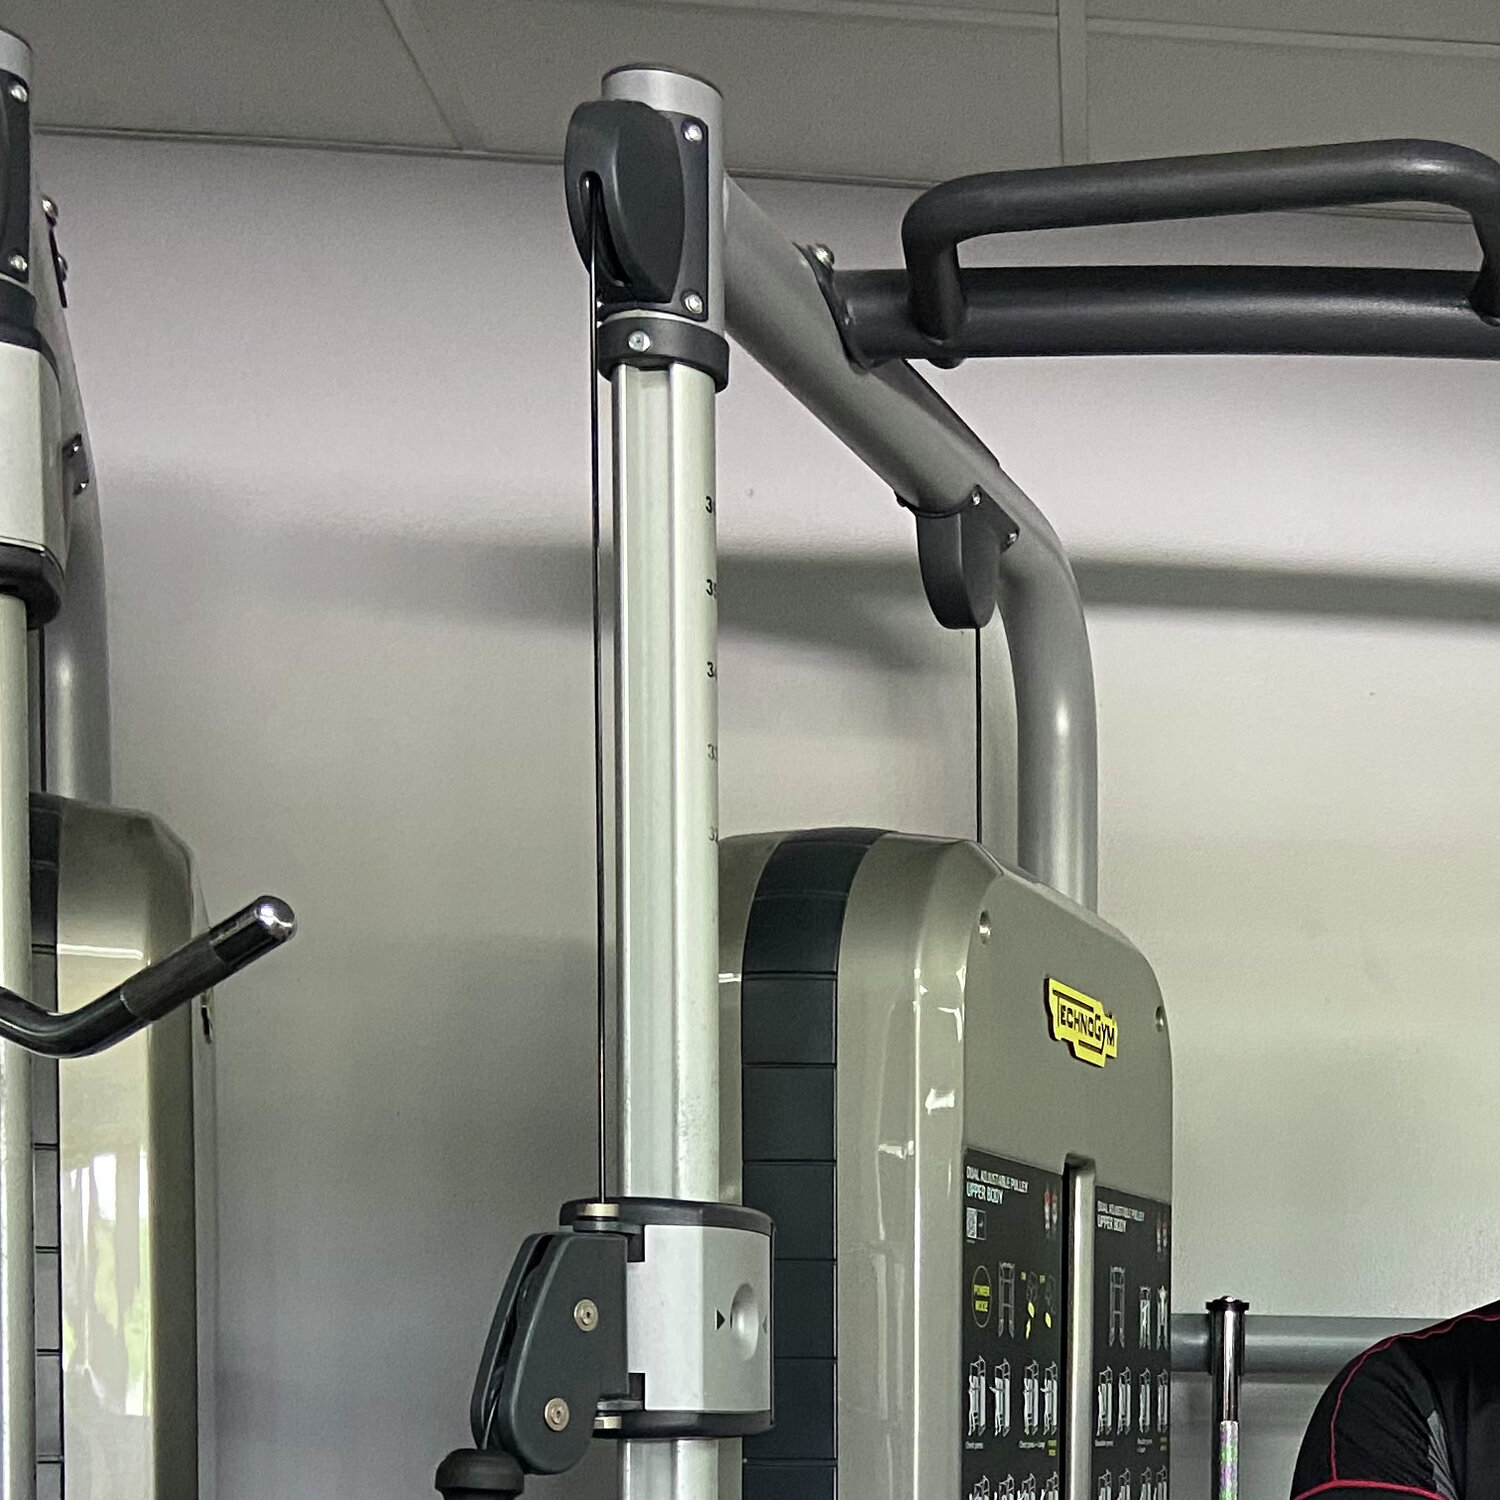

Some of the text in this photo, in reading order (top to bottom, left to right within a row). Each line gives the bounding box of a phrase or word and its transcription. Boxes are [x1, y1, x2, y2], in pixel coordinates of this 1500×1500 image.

[1052, 988, 1115, 1055] TECHNOGYM
[966, 1181, 1004, 1205] UPPER BODY
